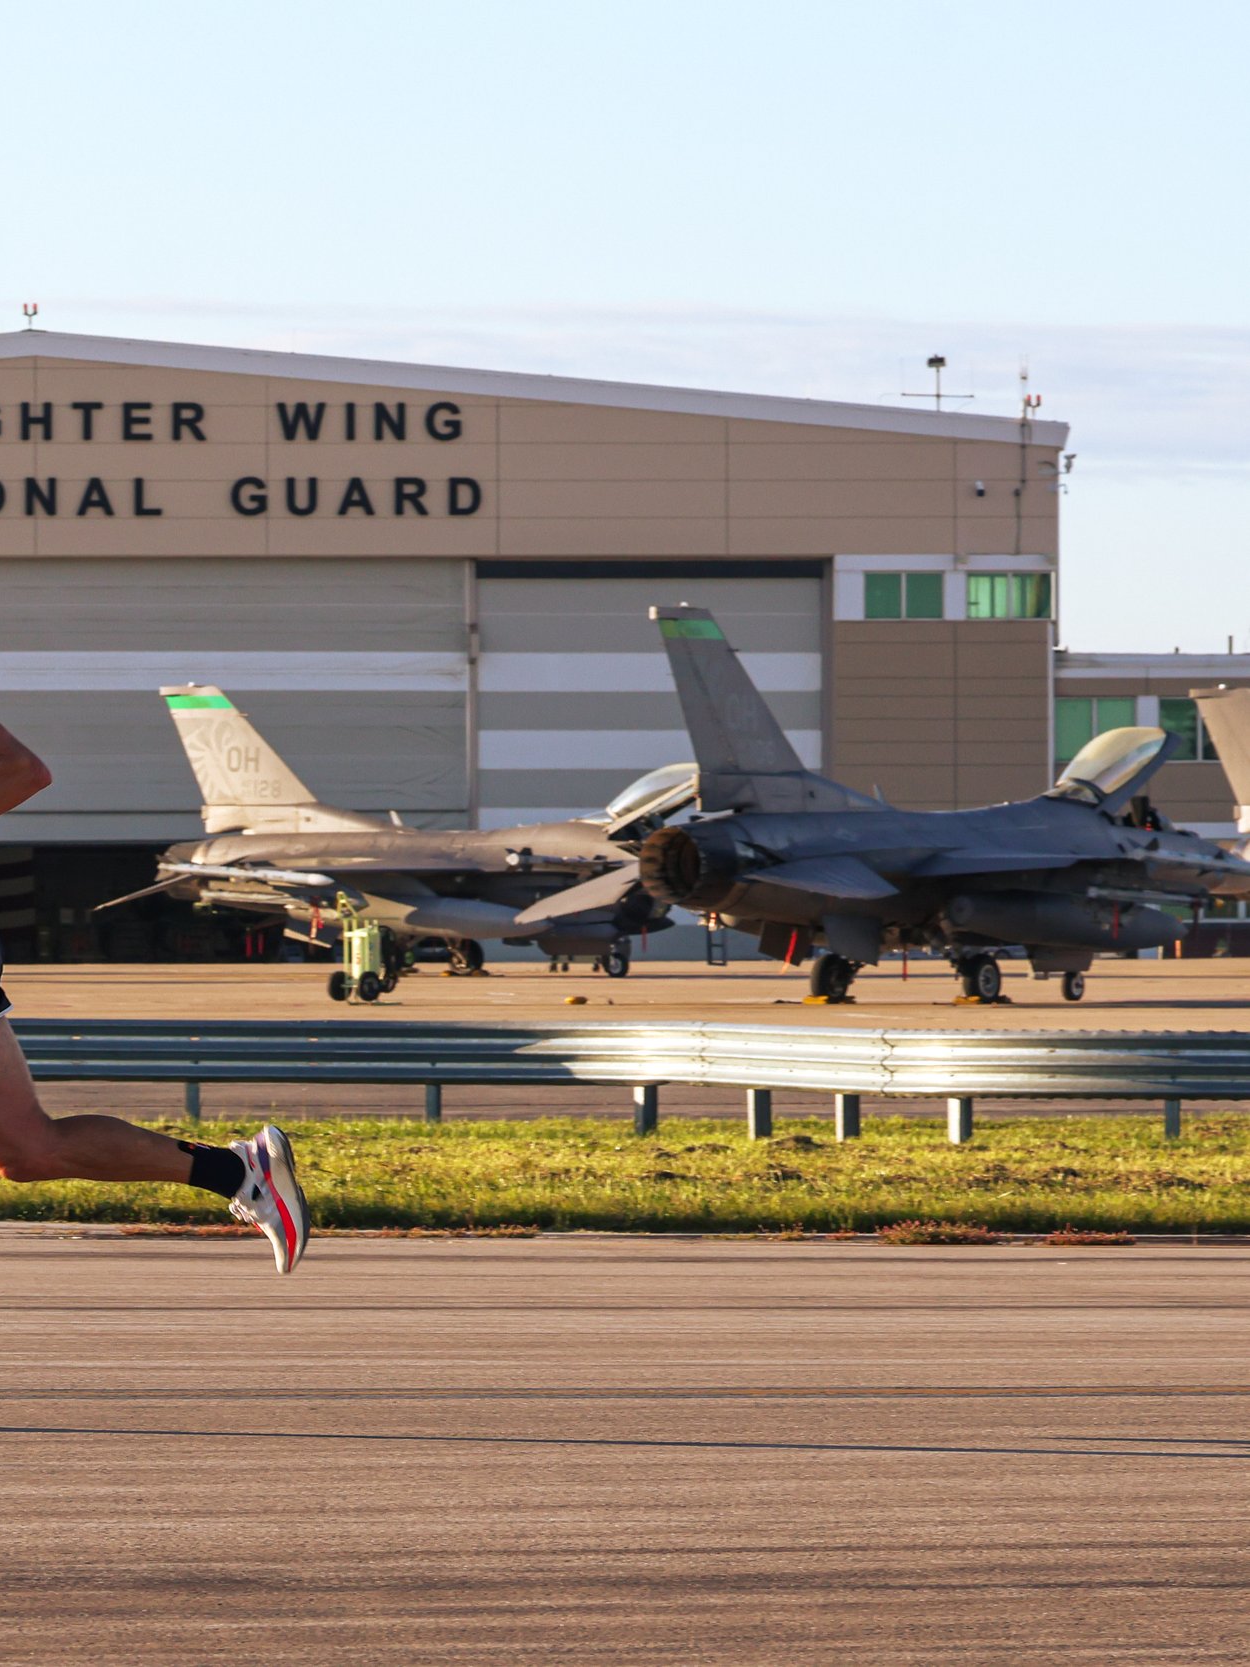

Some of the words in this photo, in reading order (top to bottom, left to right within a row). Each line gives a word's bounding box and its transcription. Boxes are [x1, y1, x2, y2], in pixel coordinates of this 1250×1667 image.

[276, 401, 462, 442] WING
[230, 476, 482, 517] GUARD
[227, 746, 260, 773] OH
